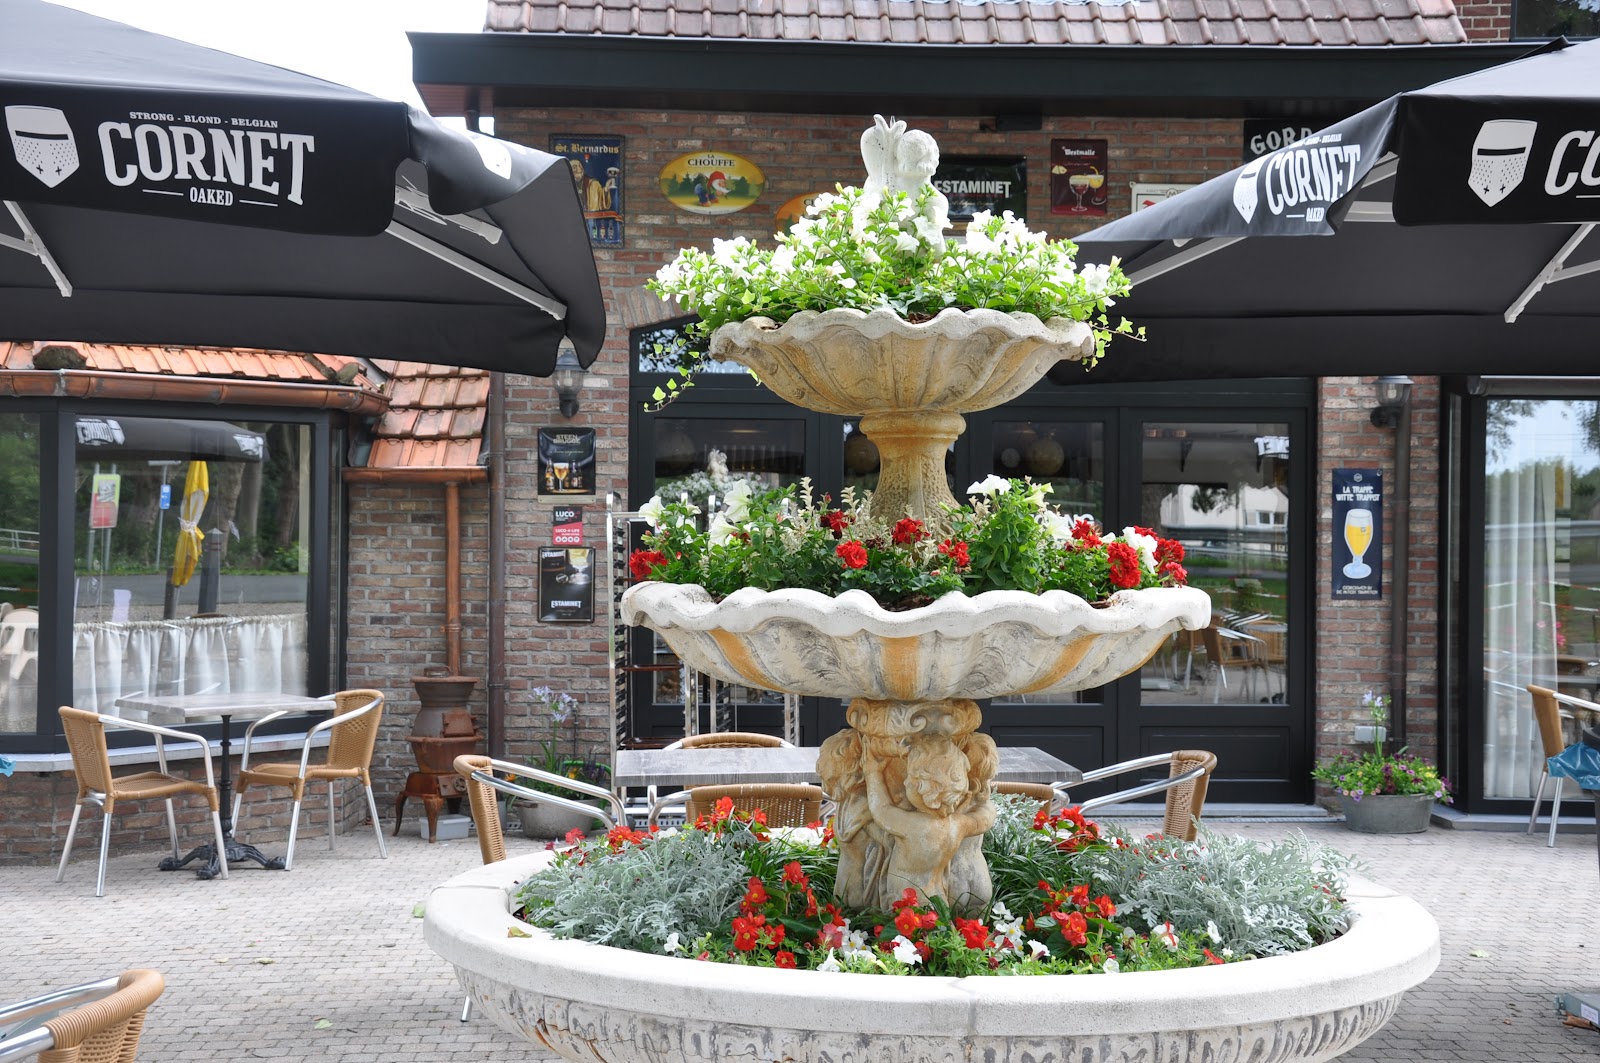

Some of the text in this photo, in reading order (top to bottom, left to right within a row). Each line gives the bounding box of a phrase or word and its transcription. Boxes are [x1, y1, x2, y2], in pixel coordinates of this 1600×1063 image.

[129, 111, 278, 128] STRONG BLOND BELGIAN
[571, 143, 619, 154] Bernardus
[1064, 148, 1095, 156] Westmalle
[98, 121, 315, 205] CORNET
[687, 159, 735, 167] CHOUFFE
[1265, 144, 1360, 215] CORNET
[189, 187, 234, 206] OAKED
[934, 181, 1012, 198] ESTAMINET
